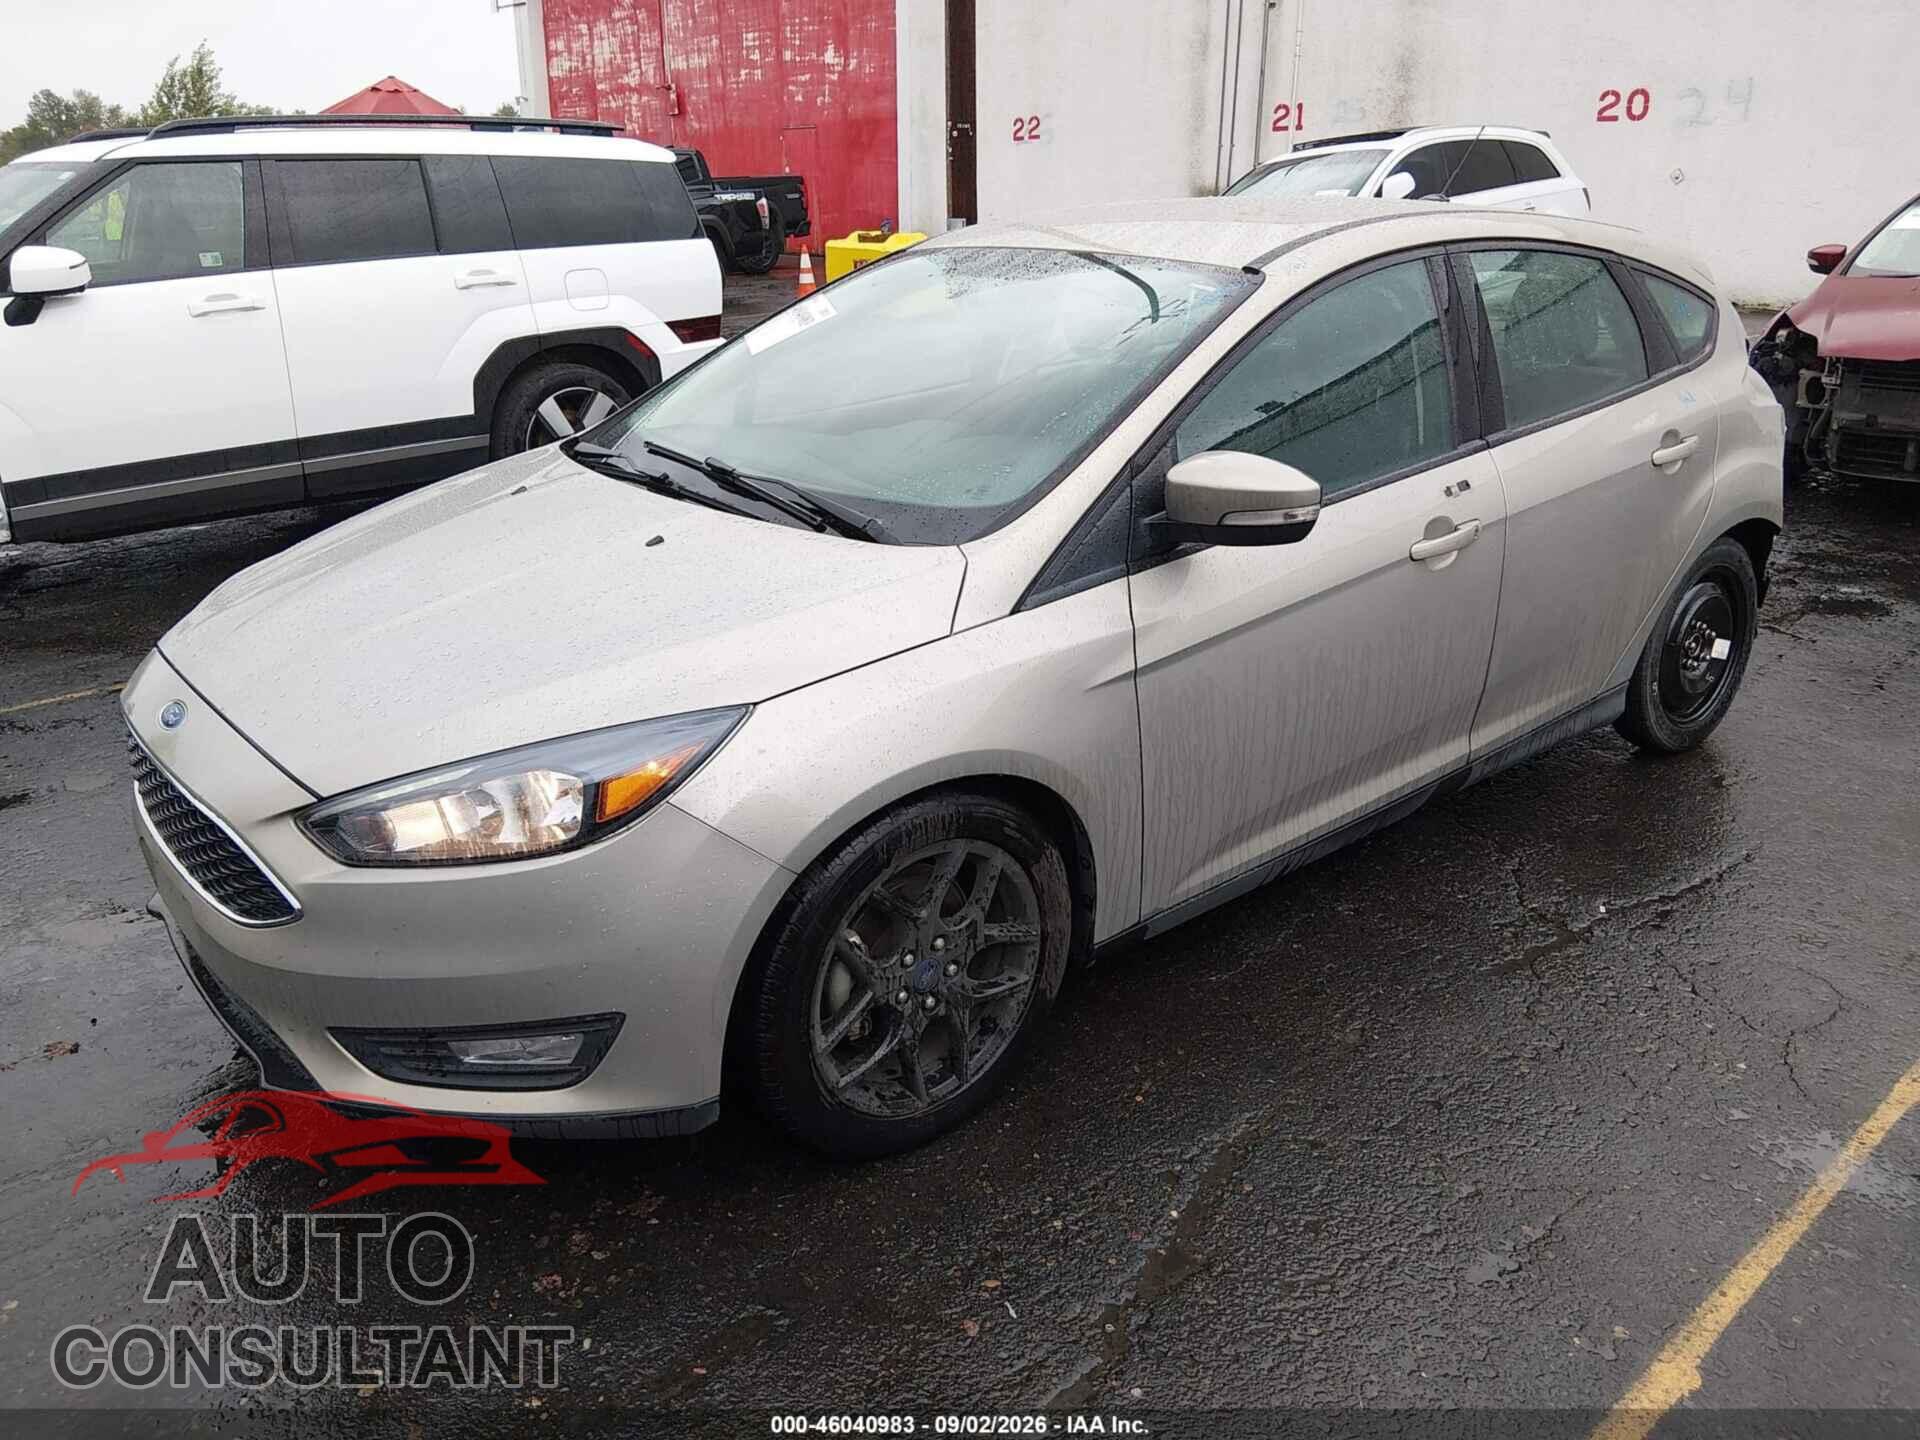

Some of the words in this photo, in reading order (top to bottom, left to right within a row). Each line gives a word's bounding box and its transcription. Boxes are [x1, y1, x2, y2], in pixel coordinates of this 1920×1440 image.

[1271, 101, 1305, 133] 21
[1595, 86, 1650, 123] 20
[1012, 115, 1041, 143] 22
